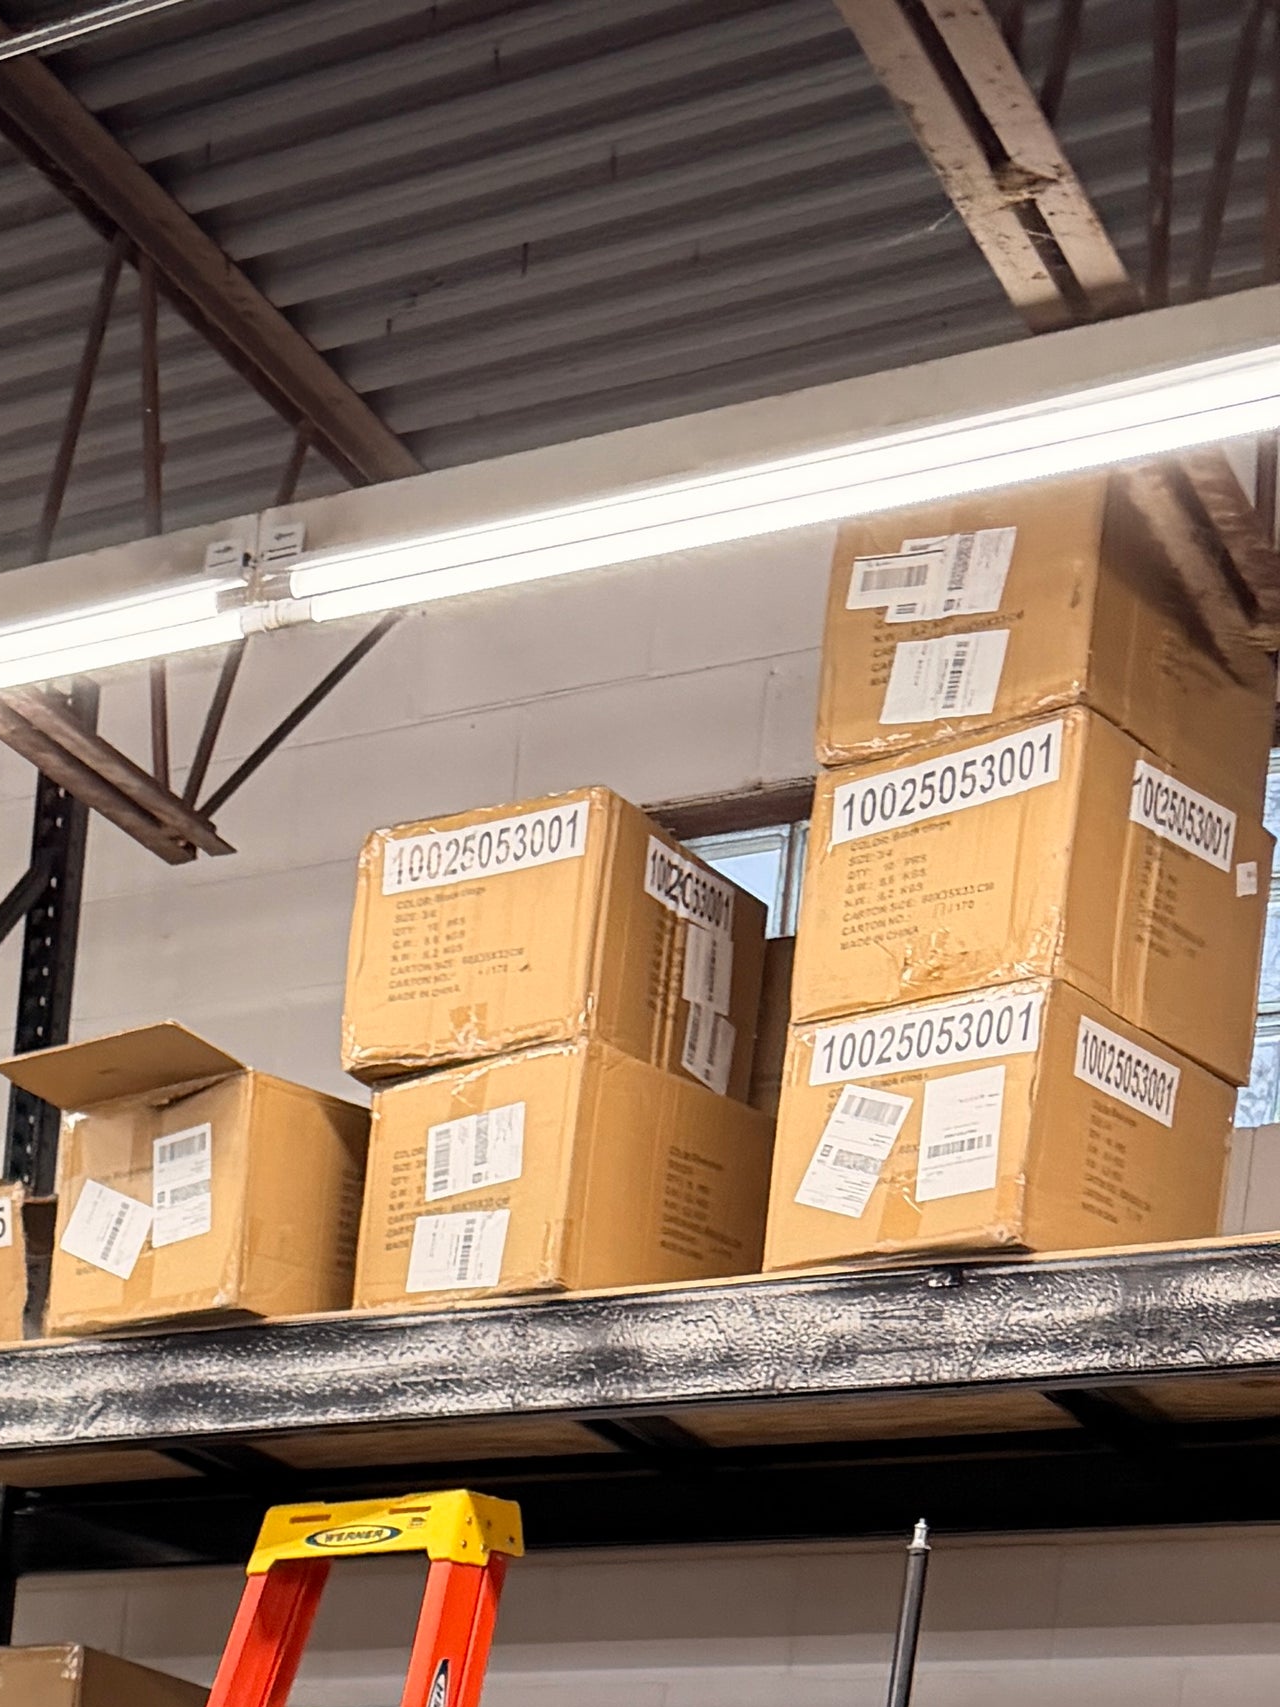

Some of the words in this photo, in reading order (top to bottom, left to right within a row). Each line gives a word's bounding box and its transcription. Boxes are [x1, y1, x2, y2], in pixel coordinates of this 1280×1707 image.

[842, 733, 1053, 832] 10025053001
[392, 809, 579, 885] 10025053001
[822, 1001, 1033, 1074] 10025053001
[1081, 1029, 1175, 1115] 10025053001
[324, 1529, 384, 1543] WERNER
